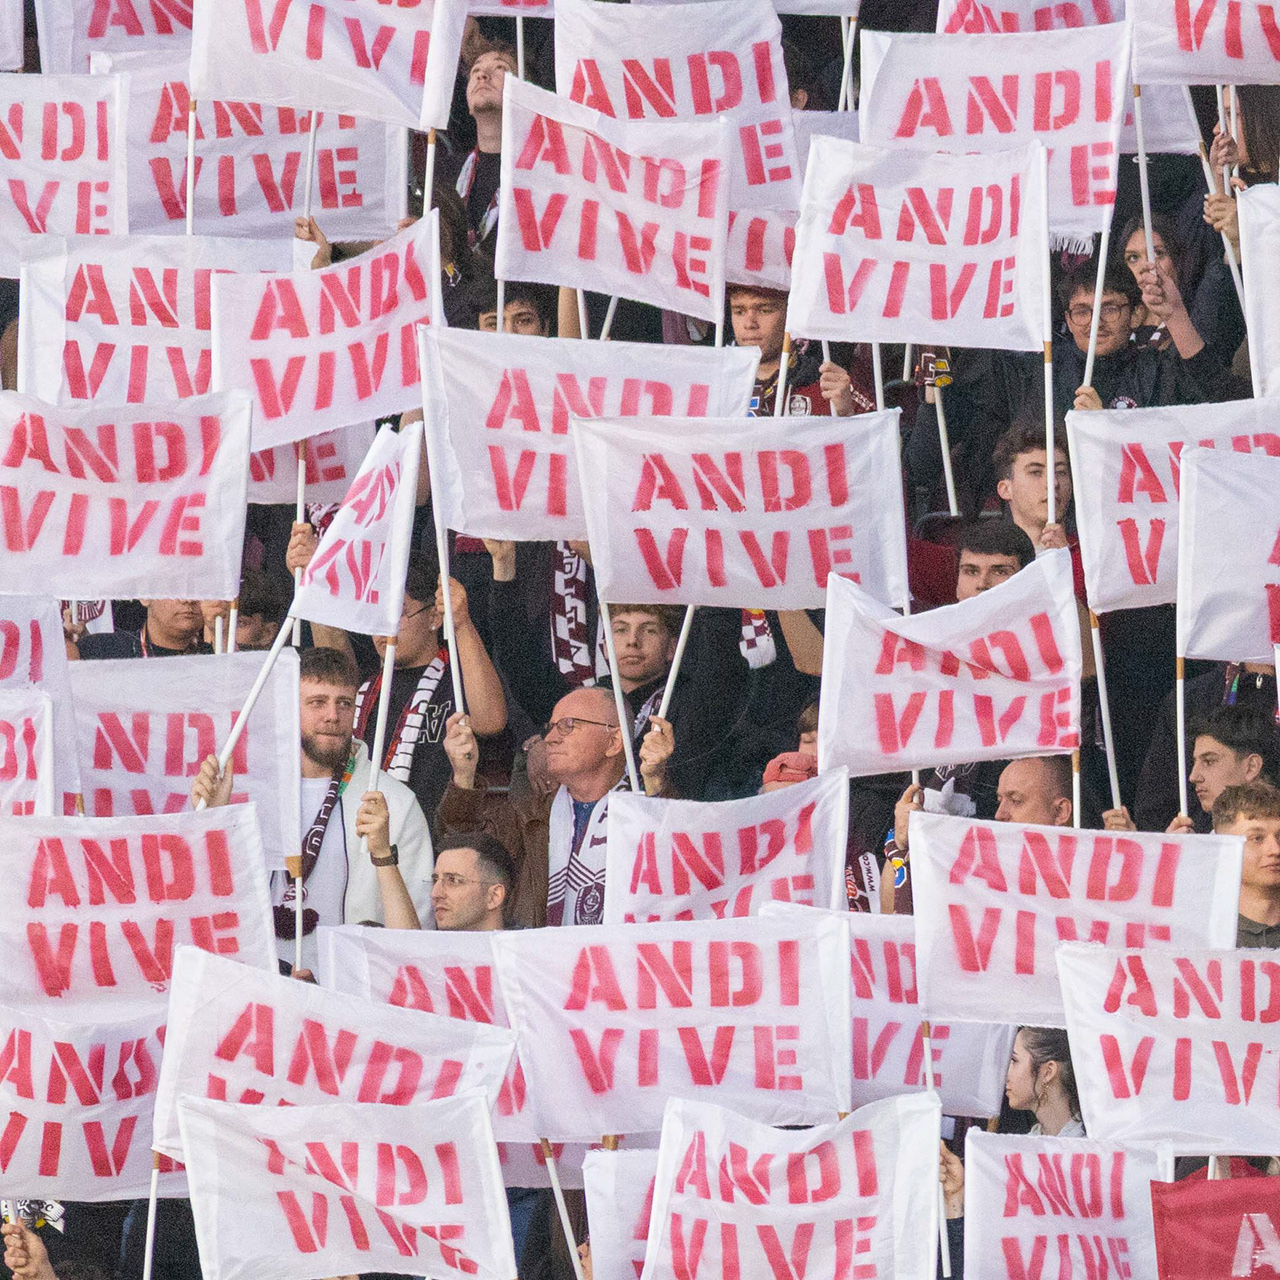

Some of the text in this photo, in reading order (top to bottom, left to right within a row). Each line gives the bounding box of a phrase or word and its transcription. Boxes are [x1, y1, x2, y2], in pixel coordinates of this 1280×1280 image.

[570, 40, 776, 119] ANDI
[896, 59, 1111, 138] ANDI
[149, 147, 362, 220] VIVE
[515, 115, 721, 218] ANDI
[513, 188, 711, 297] VIVE
[829, 172, 1019, 246] ANDI
[250, 241, 426, 340] ANDI
[823, 252, 1014, 321] VIVE
[3, 413, 219, 484] ANDI
[632, 443, 848, 512] ANDI
[0, 485, 205, 556] VIVE
[636, 525, 861, 590] VIVE
[875, 611, 1063, 681] ANDI
[874, 687, 1079, 753] VIVE
[27, 829, 233, 909] ANDI
[631, 802, 815, 895] ANDI
[950, 826, 1181, 907] ANDI
[27, 911, 239, 996] VIVE
[564, 939, 799, 1010] ANDI
[0, 1026, 165, 1106] AND
[215, 1002, 463, 1103] ANDI
[570, 1024, 802, 1093] VIVE
[676, 1129, 878, 1205] ANDI
[1003, 1151, 1125, 1219] ANDI
